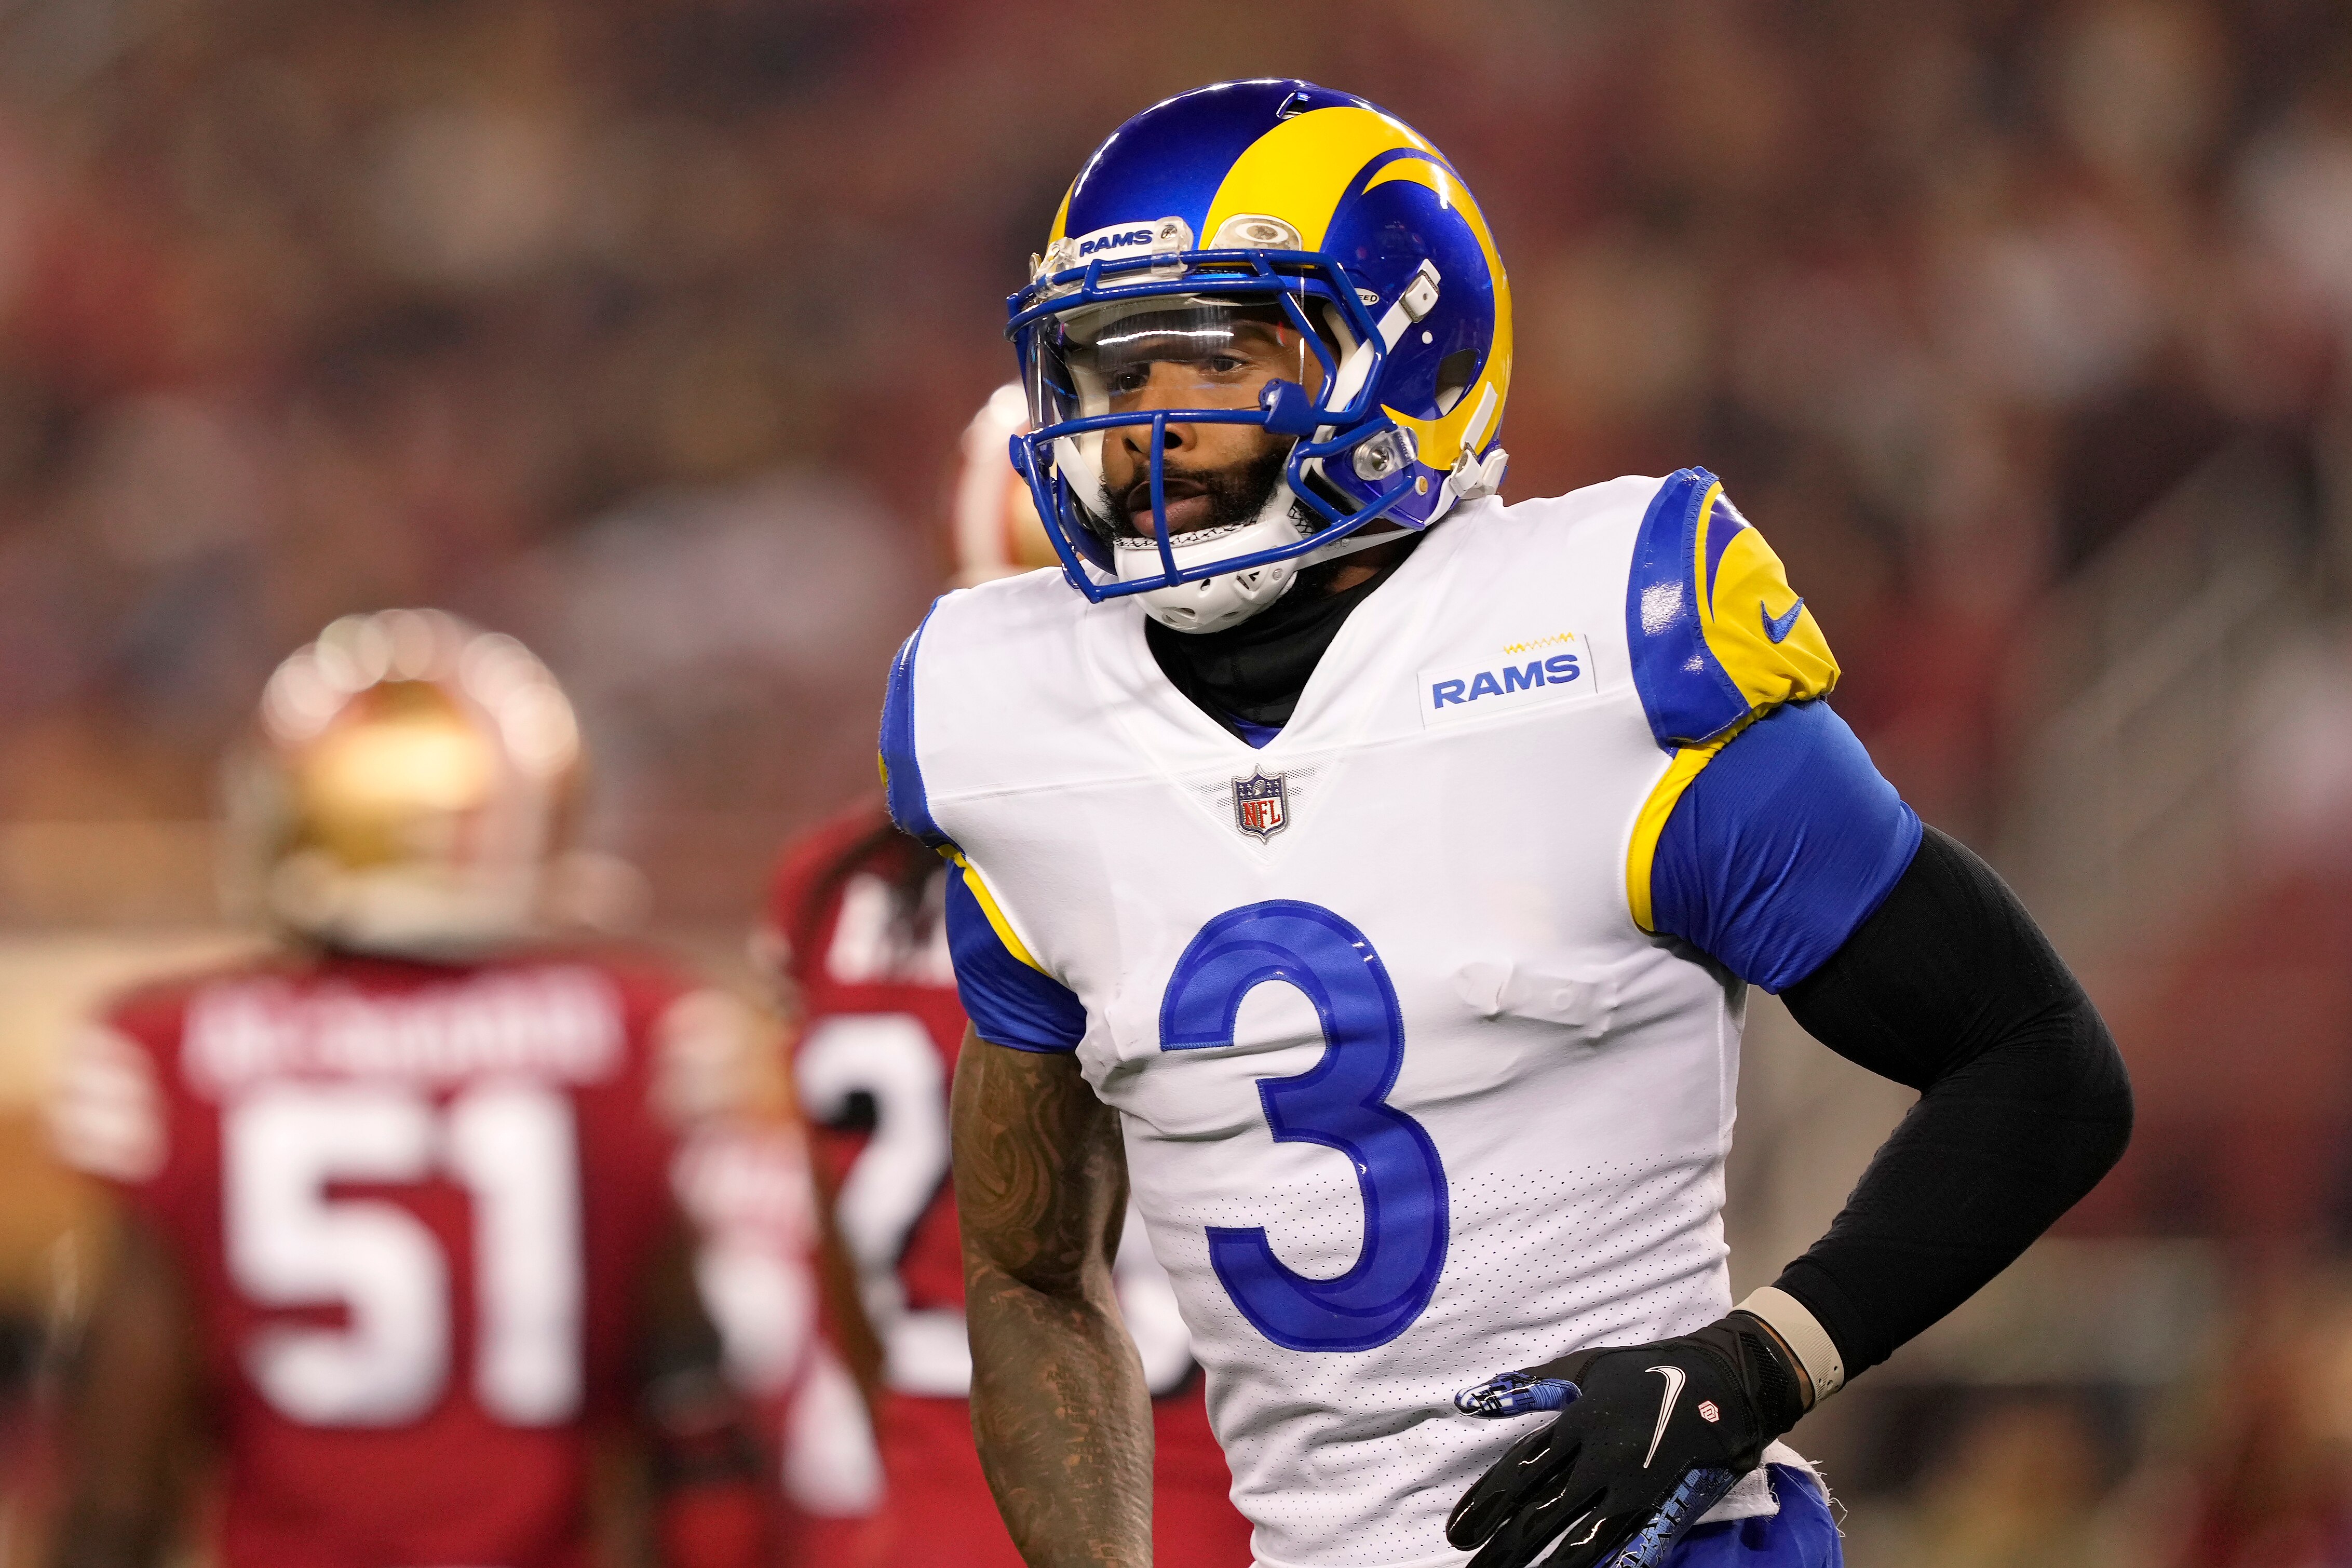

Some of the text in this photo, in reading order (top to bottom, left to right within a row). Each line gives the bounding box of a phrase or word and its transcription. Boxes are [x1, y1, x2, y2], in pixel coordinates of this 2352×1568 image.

[1079, 229, 1153, 258] RAMS
[1432, 654, 1580, 709] RAMS
[1240, 799, 1281, 829] NFL
[1159, 899, 1450, 1353] 3
[220, 1080, 585, 1427] 51
